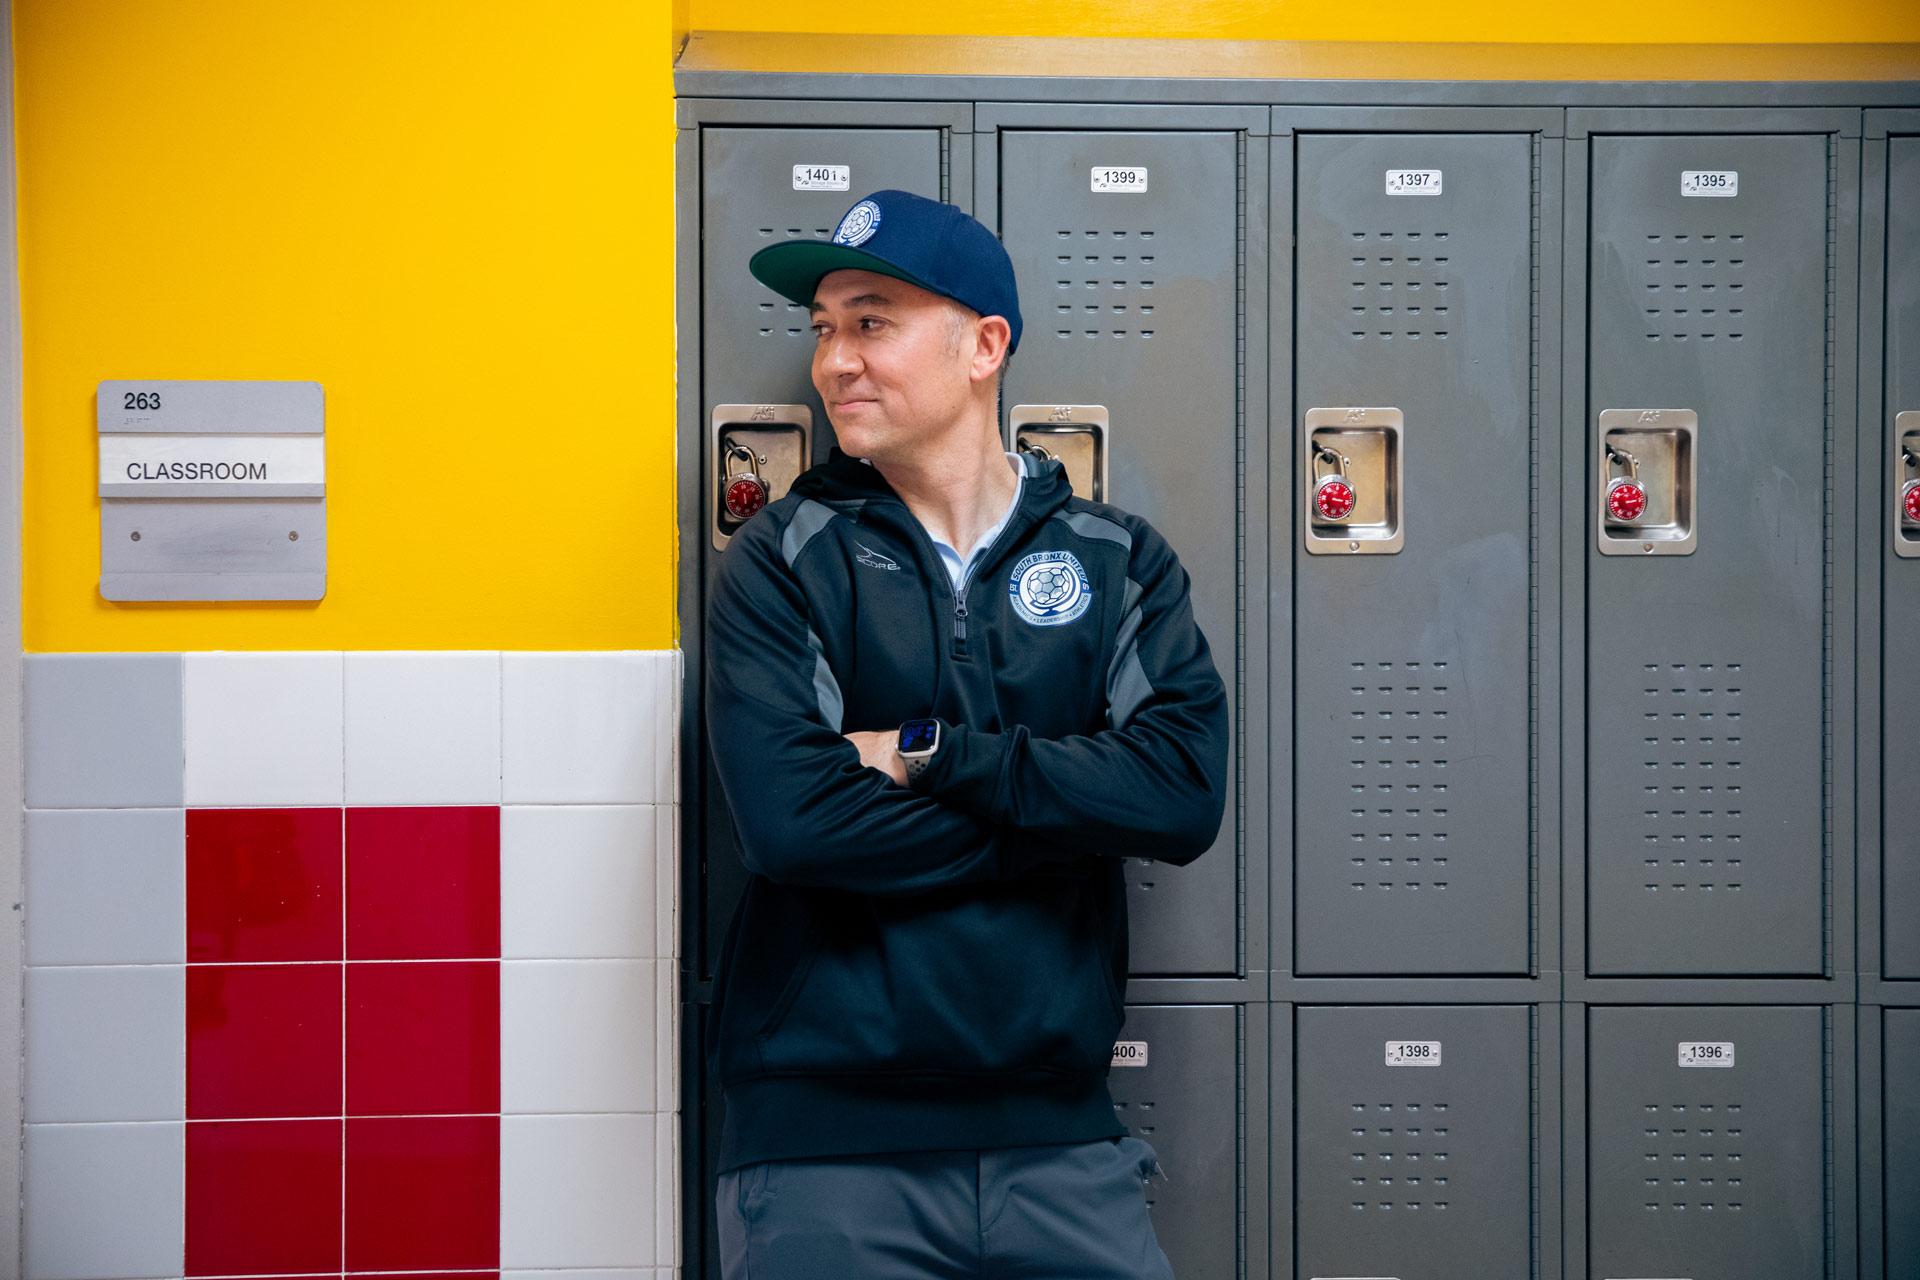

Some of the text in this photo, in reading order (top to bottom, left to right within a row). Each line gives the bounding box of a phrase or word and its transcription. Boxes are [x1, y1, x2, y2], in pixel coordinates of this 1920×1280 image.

[1104, 171, 1136, 184] 1399
[1398, 173, 1430, 186] 1397
[1694, 174, 1726, 187] 1395
[124, 392, 161, 410] 263
[127, 462, 267, 480] CLASSROOM
[1013, 557, 1033, 580] SOUTH
[1032, 552, 1061, 562] BRONX
[1113, 1045, 1136, 1058] 400
[1398, 1045, 1430, 1057] 1398
[1690, 1046, 1722, 1058] 1396
